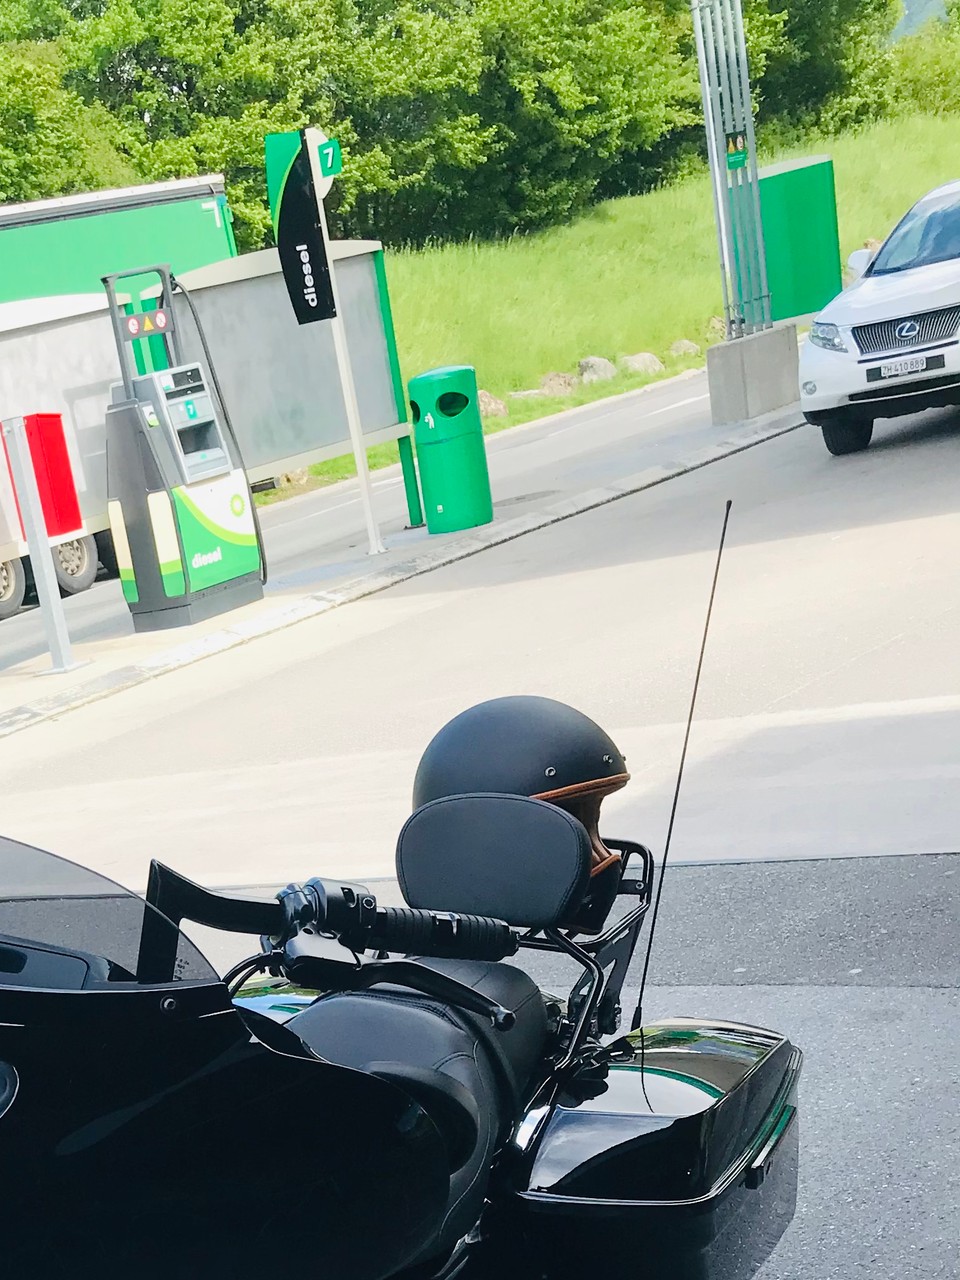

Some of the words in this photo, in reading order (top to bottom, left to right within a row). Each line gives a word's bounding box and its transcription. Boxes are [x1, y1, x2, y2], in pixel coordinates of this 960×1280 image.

[322, 147, 334, 169] 7
[296, 244, 318, 308] diesel
[192, 546, 222, 568] diesel
